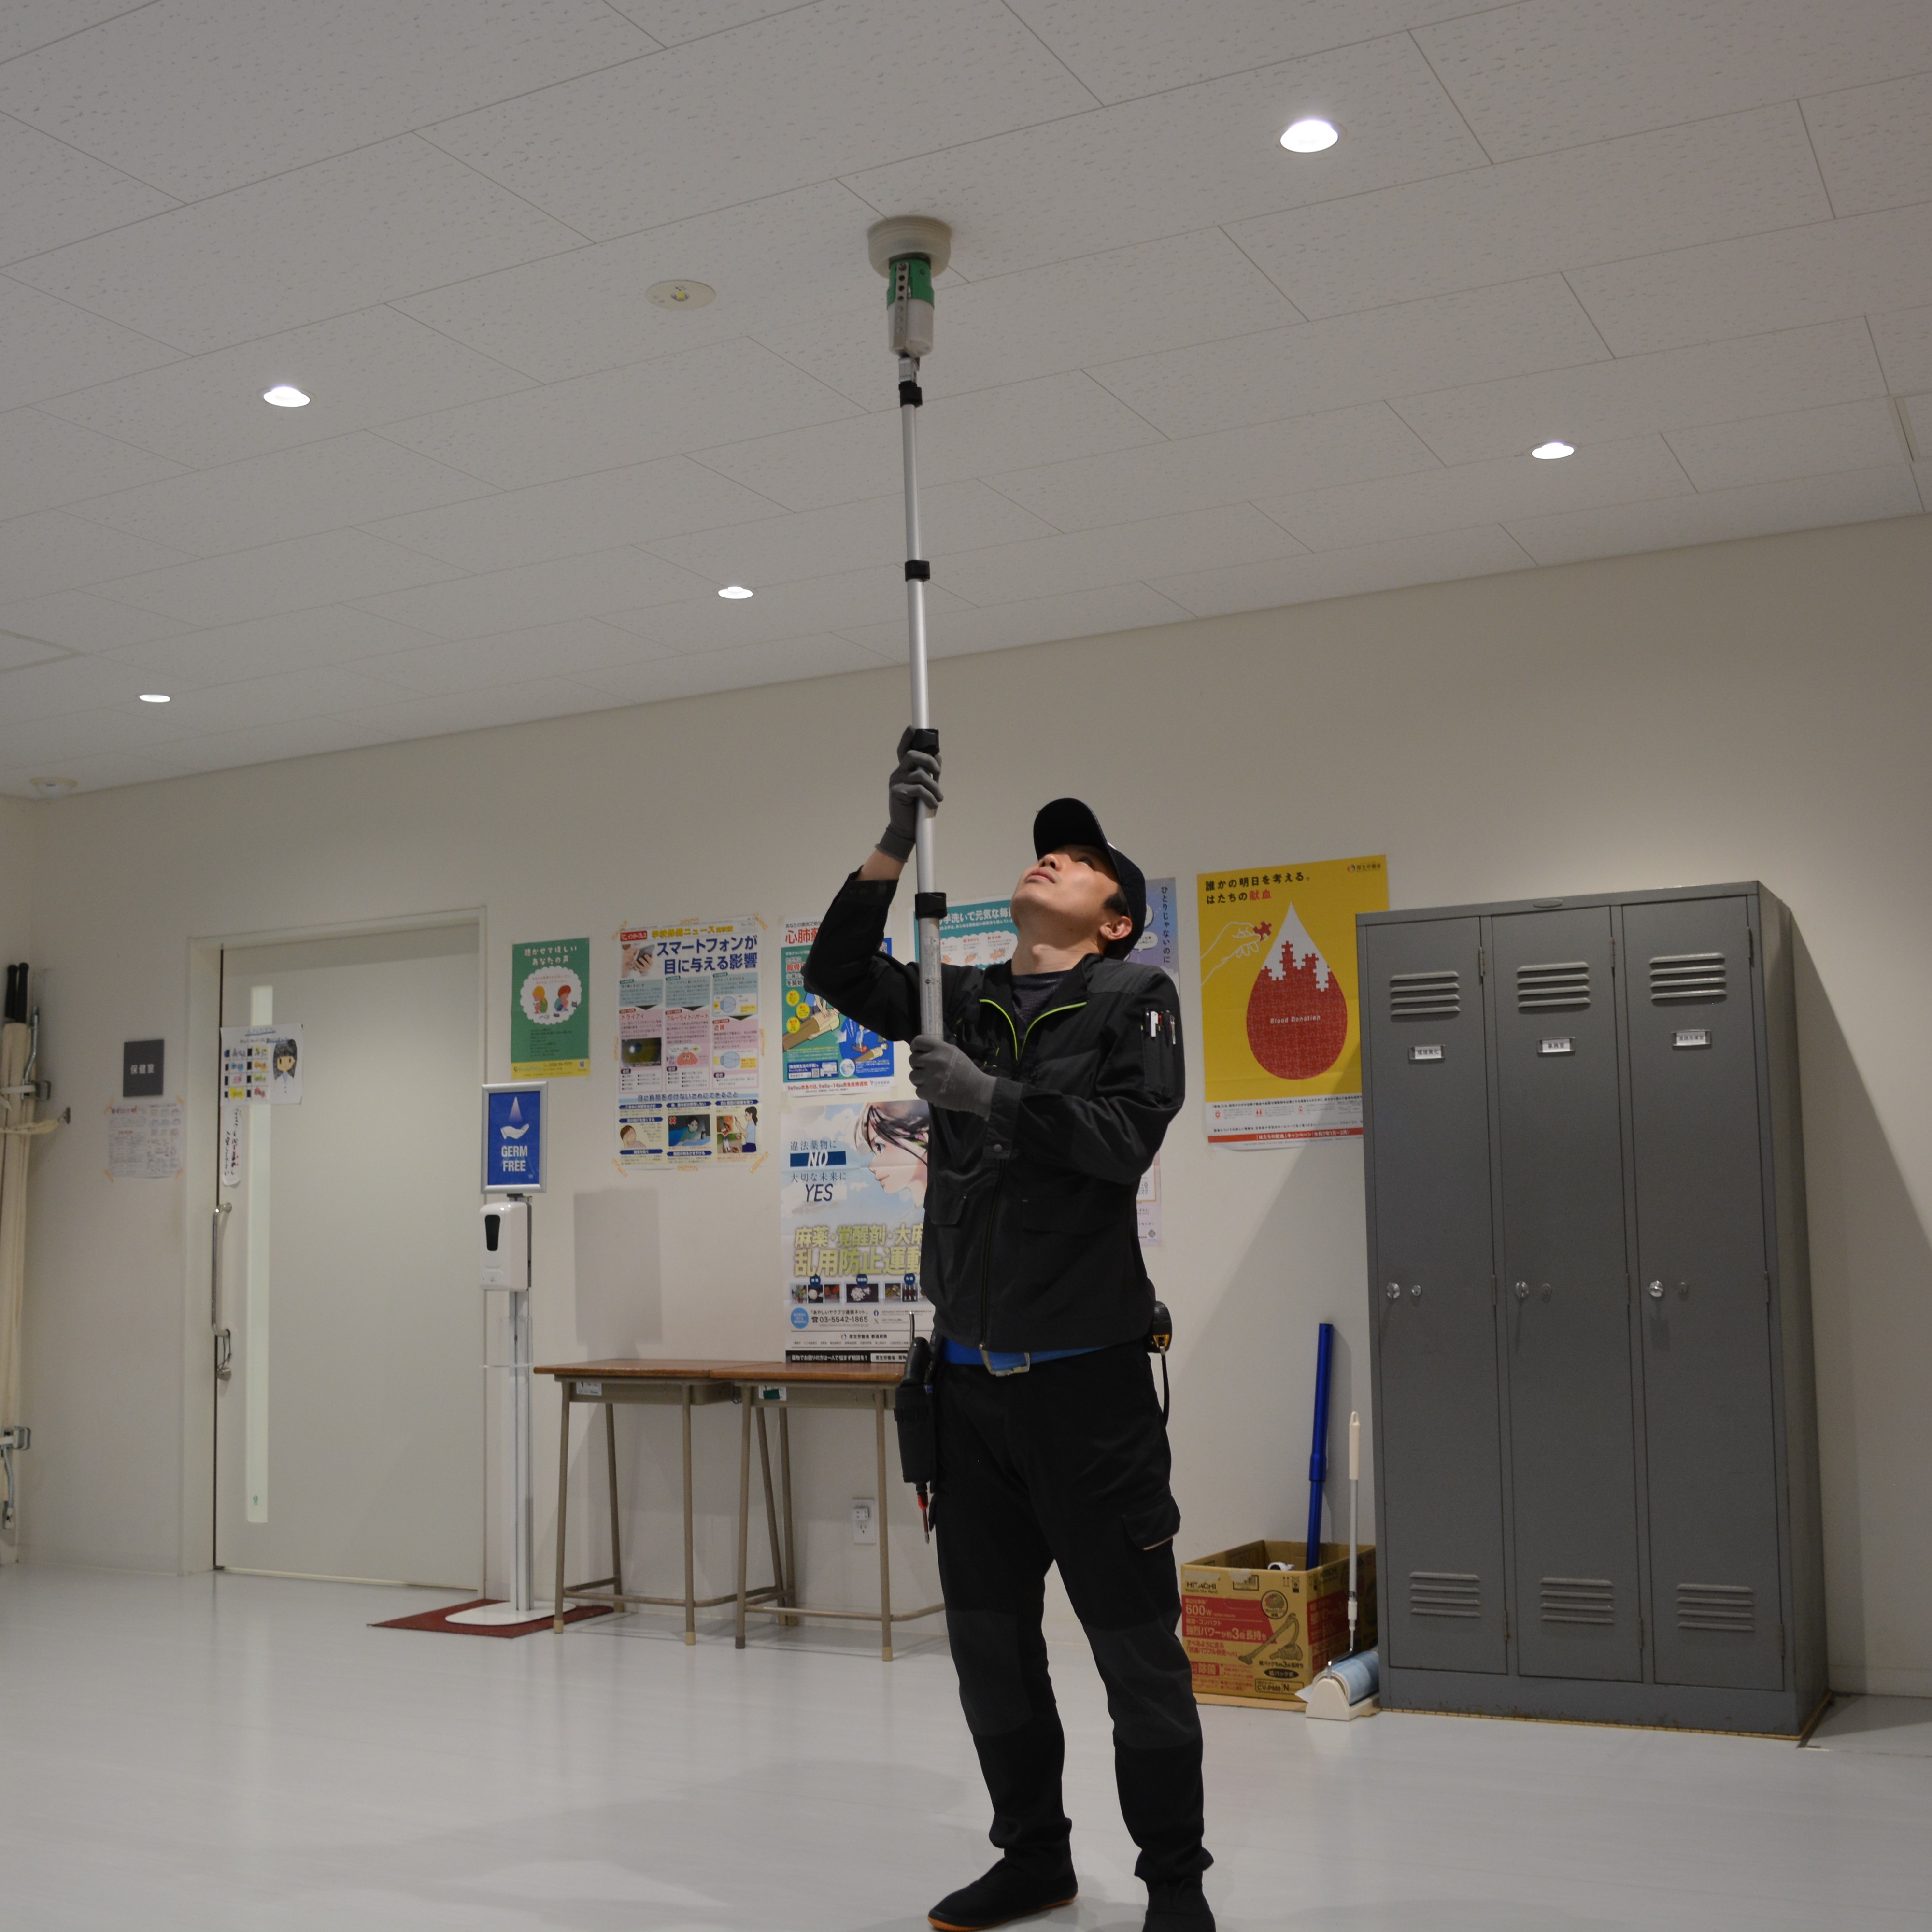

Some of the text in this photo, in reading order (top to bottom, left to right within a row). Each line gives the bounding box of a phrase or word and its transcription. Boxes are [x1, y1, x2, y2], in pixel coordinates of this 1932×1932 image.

[1205, 872, 1310, 892] 誰かの明日を考える。
[1207, 889, 1271, 905] はたちの献血
[1161, 886, 1171, 964] ひとりじゃないのに
[524, 945, 577, 957] 聴かせてほしい
[657, 935, 757, 957] スマートフォンが
[532, 955, 569, 966] あなたの声
[664, 952, 757, 975] 目に与える影響
[787, 963, 805, 972] 胸骨
[1291, 1015, 1321, 1023] Donation
[131, 1064, 155, 1075] 保健室
[638, 1092, 738, 1102] 目に負担をかけないためにできること
[501, 1145, 527, 1157] GERM
[790, 1140, 836, 1151] 違法薬物に
[808, 1150, 829, 1169] NO
[503, 1160, 526, 1172] FREE
[792, 1172, 847, 1183] 大切な未来に
[805, 1183, 833, 1202] YES
